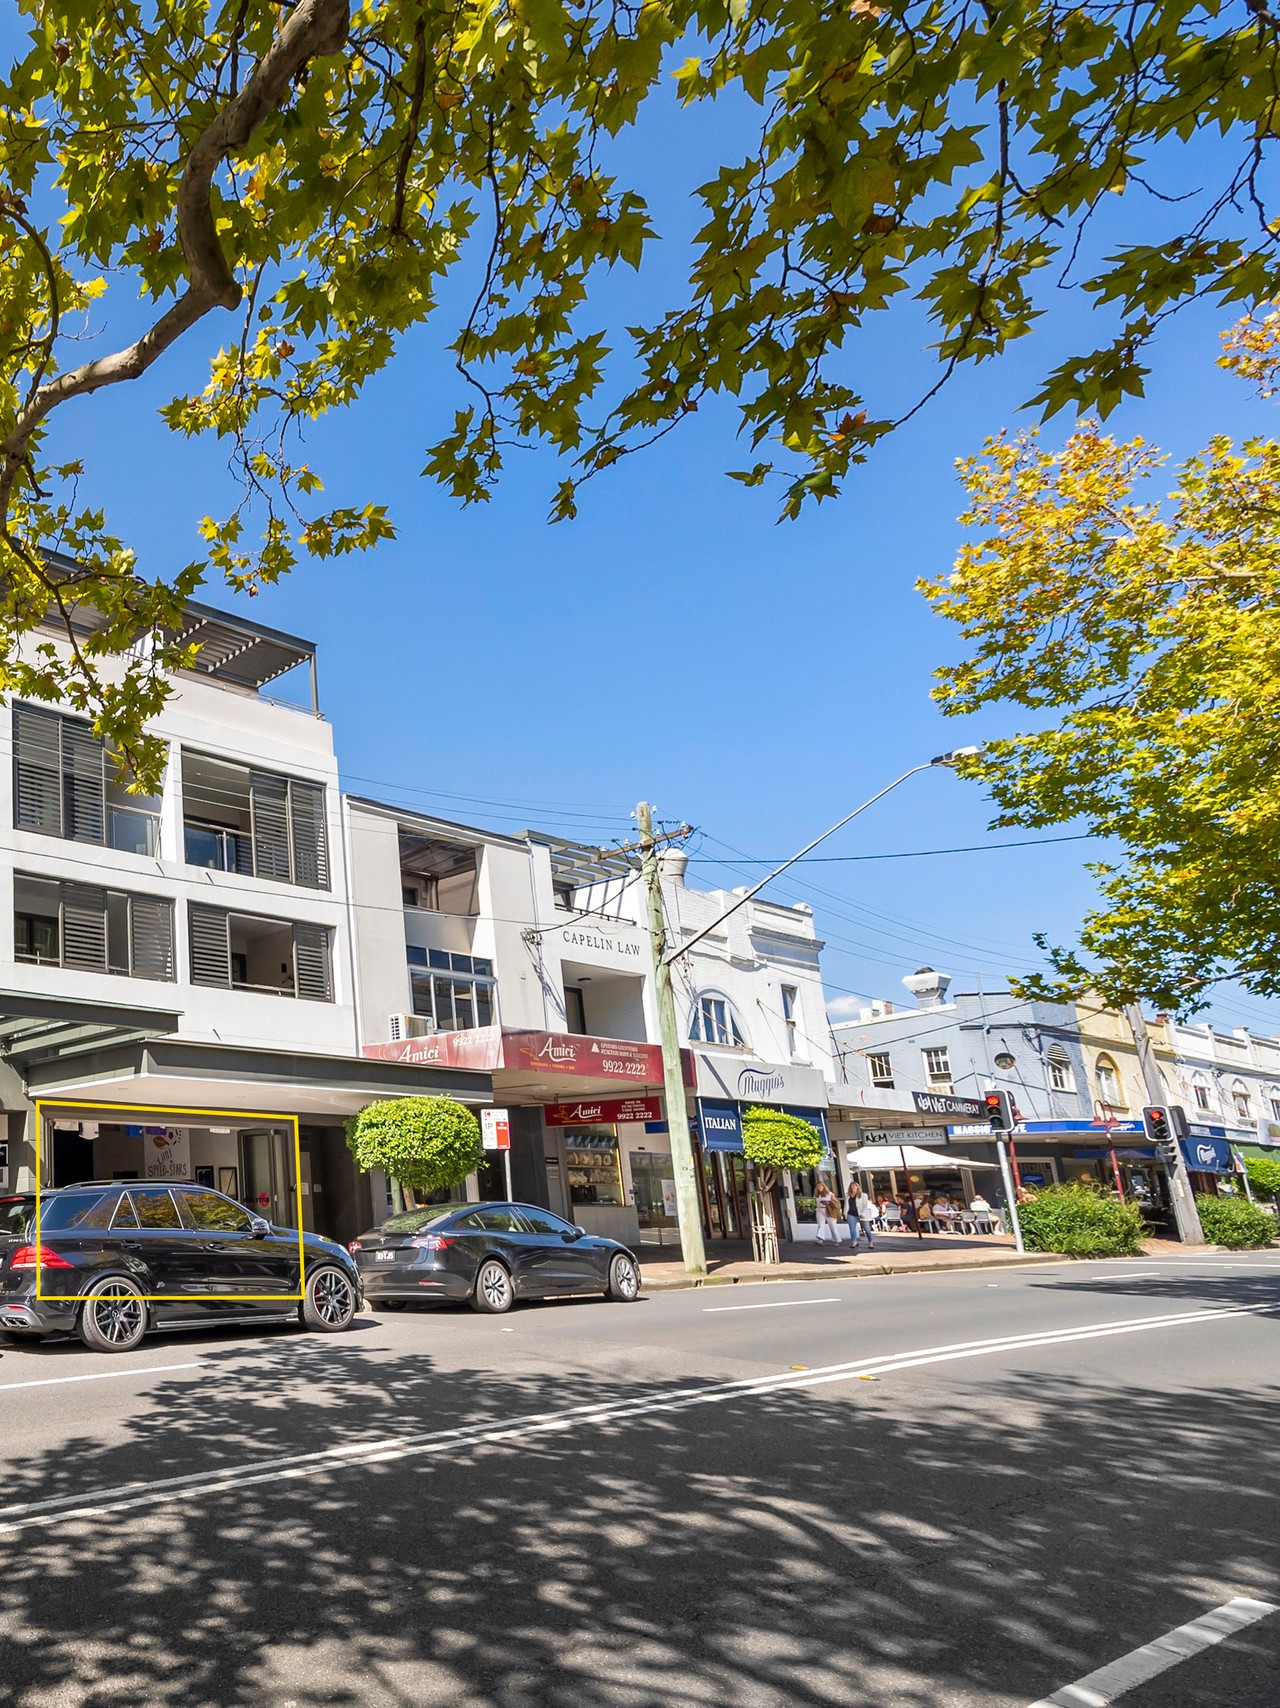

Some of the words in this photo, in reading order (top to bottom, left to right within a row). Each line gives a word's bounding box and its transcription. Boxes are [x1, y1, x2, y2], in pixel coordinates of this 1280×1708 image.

[562, 930, 613, 951] CAPELIN
[617, 941, 641, 956] LAW
[398, 1043, 442, 1064] Amici
[538, 1037, 577, 1062] Amici
[602, 1059, 624, 1074] 9922
[625, 1061, 647, 1076] 2222
[738, 1068, 785, 1098] Maggio's
[569, 1104, 603, 1119] Amici
[616, 1112, 634, 1120] 9922
[635, 1111, 653, 1119] 2222
[705, 1116, 737, 1131] ITALIAN
[906, 1131, 943, 1139] KITCHEN
